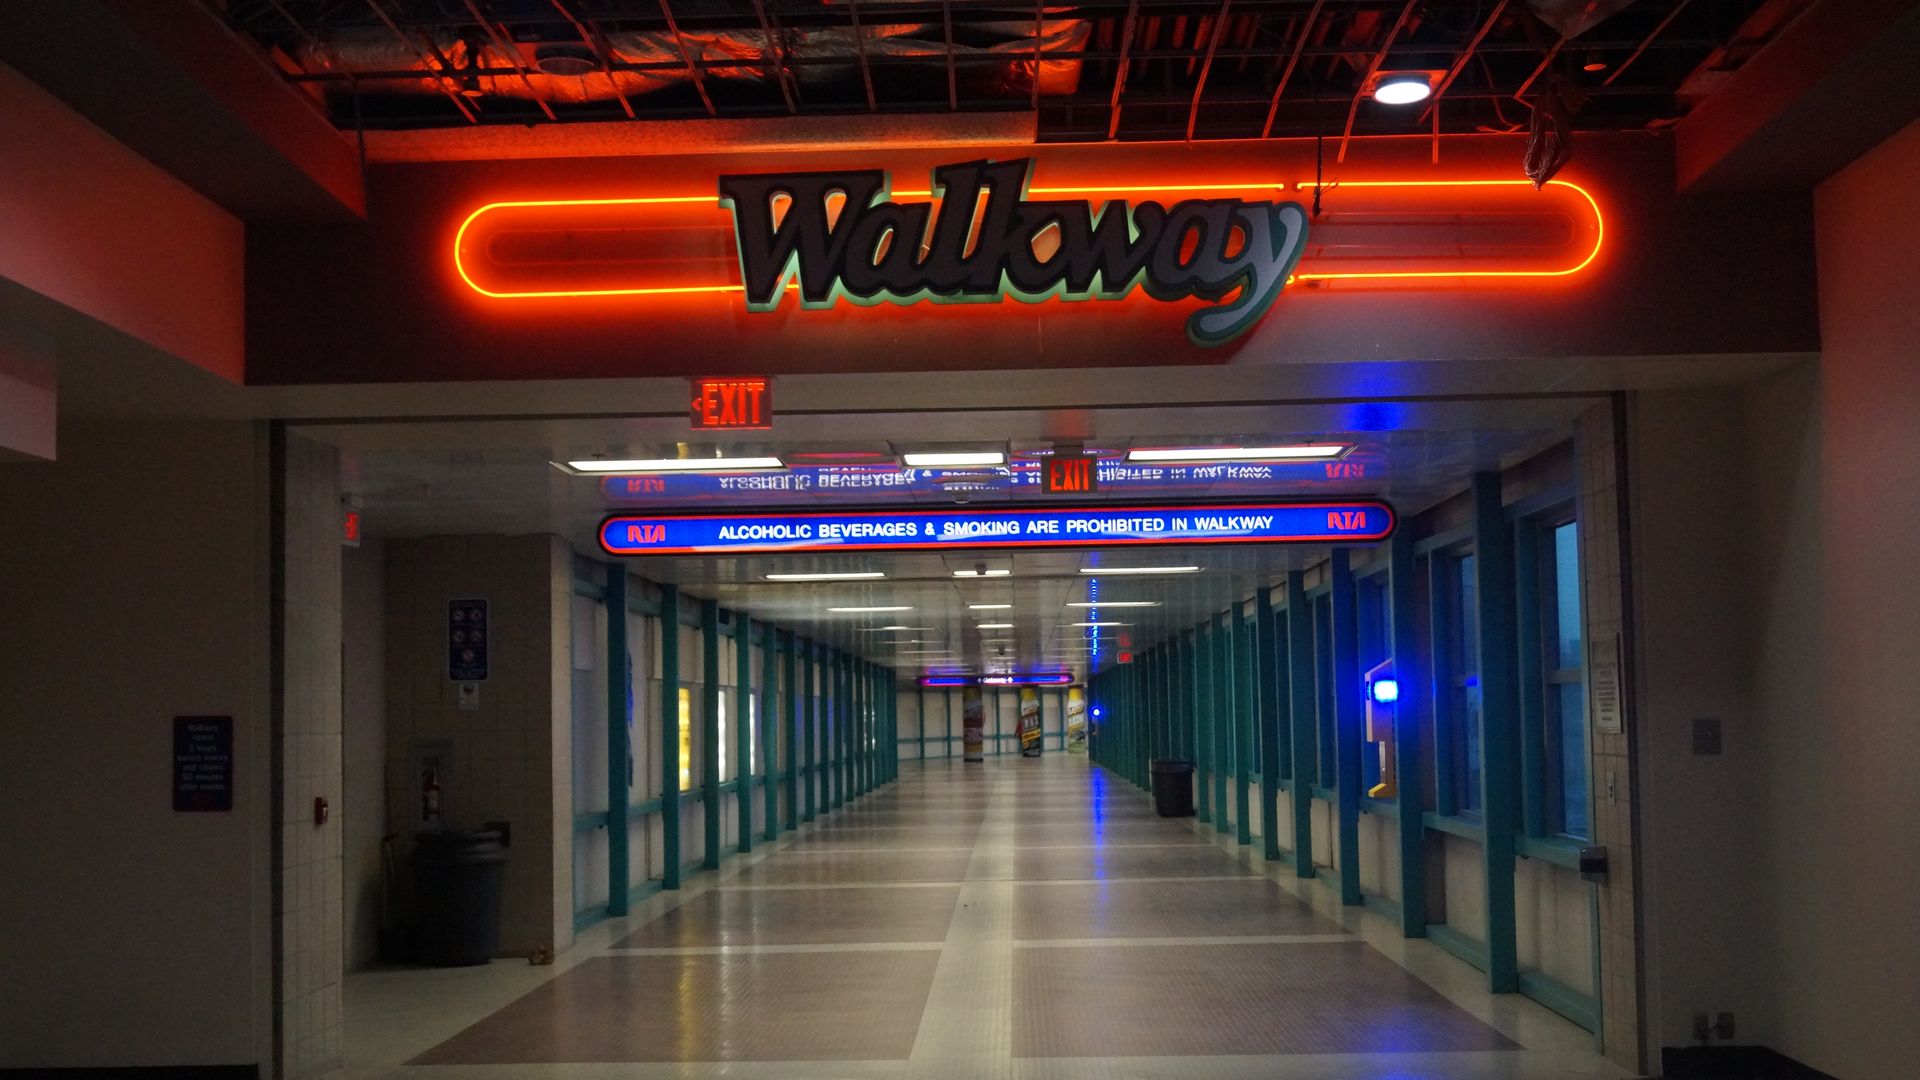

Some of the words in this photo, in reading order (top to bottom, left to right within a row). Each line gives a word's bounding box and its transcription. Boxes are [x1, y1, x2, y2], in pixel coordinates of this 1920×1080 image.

[719, 158, 1309, 348] Walkway
[702, 382, 765, 426] EXIT
[1050, 459, 1091, 491] EXIT
[627, 524, 665, 543] RTA
[718, 525, 812, 540] ALCOHOLIC
[818, 522, 917, 538] BEVERAGES
[925, 522, 936, 536] &
[942, 519, 1020, 536] SMOKING
[1026, 519, 1059, 534] ARE
[1066, 517, 1165, 533] PROHIBITED
[1171, 517, 1186, 531] IN
[1196, 515, 1274, 530] WALKWAY
[1328, 511, 1366, 530] RTA
